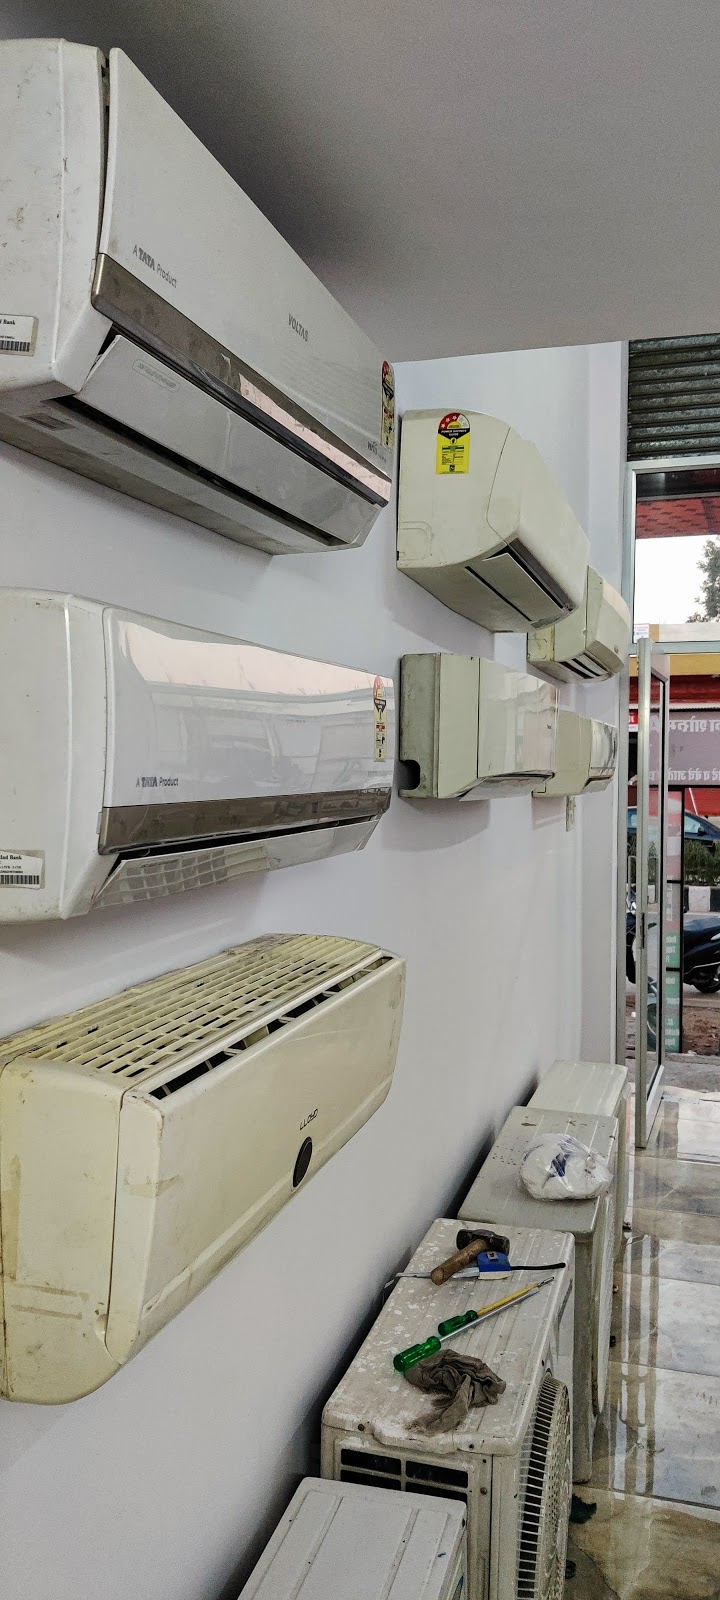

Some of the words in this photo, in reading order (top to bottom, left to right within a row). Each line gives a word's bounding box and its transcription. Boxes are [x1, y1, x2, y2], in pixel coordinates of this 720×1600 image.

[133, 244, 138, 257] A
[139, 247, 155, 271] TATA
[157, 263, 177, 288] Product
[288, 313, 309, 342] VOLTAS
[135, 776, 140, 788] A
[141, 776, 158, 788] TATA
[159, 776, 179, 787] Product
[299, 1108, 319, 1131] LLOYD
